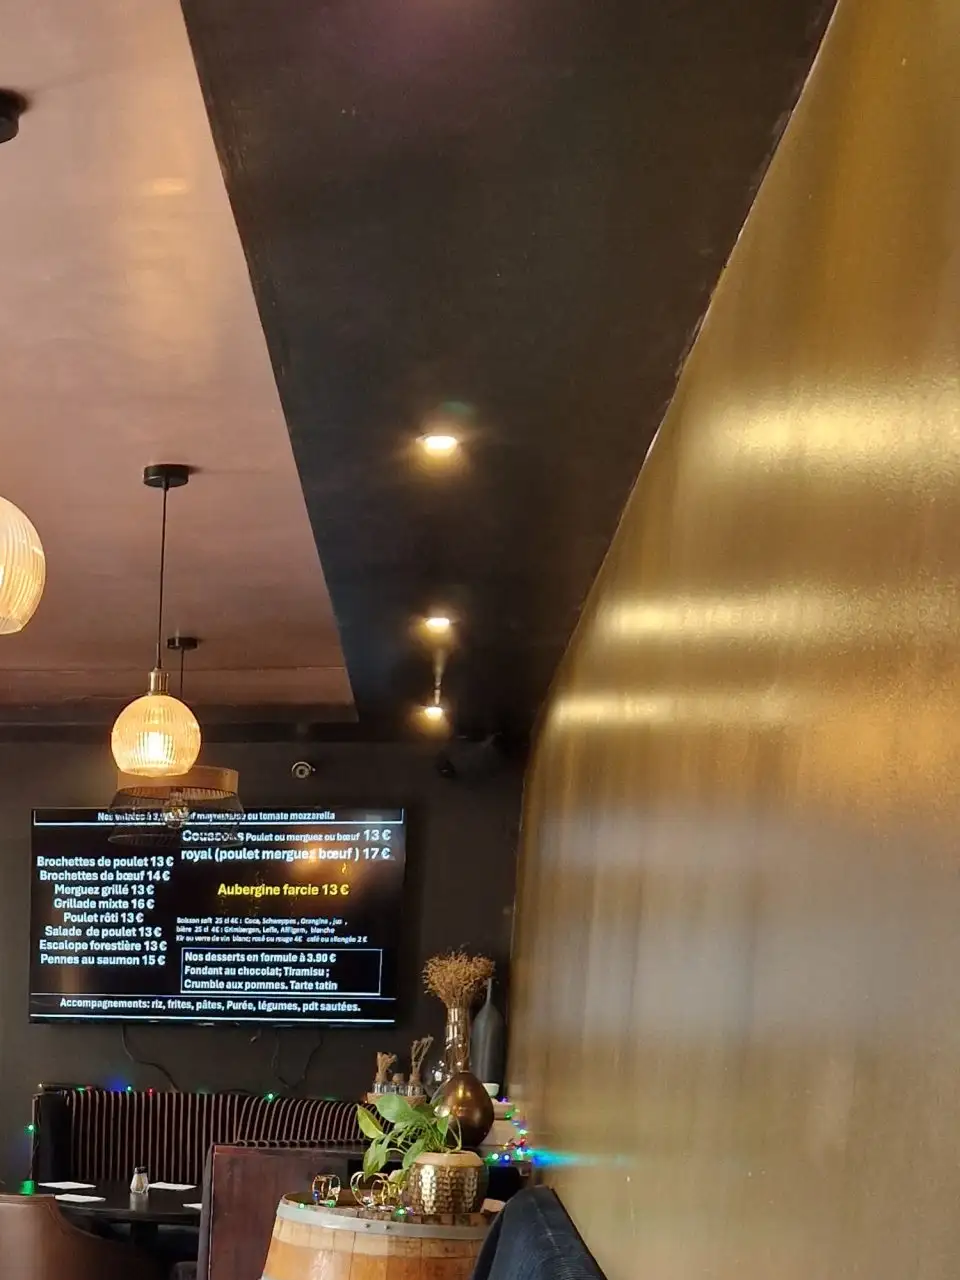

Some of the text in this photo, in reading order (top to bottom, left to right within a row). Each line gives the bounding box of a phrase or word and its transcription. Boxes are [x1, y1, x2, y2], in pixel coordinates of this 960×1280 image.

[259, 812, 288, 820] tomate
[290, 812, 335, 820] mozzarella
[246, 833, 273, 841] Poulet
[287, 834, 323, 842] merguez
[364, 830, 379, 841] 13
[382, 830, 391, 841] €
[181, 848, 212, 862] royal
[215, 848, 260, 862] (poulet
[262, 850, 317, 862] merguez
[363, 848, 379, 859] 17
[381, 848, 390, 859] €
[37, 856, 95, 866] Brochettes
[97, 856, 111, 867] de
[113, 856, 148, 868] poulet
[151, 856, 164, 867] 13
[40, 870, 98, 880] Brochettes
[100, 870, 114, 880] de
[116, 870, 145, 881] bœuf
[147, 871, 160, 881] 14
[55, 884, 100, 896] Merguez
[102, 884, 129, 896] grillé
[131, 884, 144, 895] 13
[218, 884, 349, 897] Aubergine farcie 13 €
[54, 898, 96, 908] Grillade
[99, 898, 129, 909] mixte
[131, 899, 145, 909] 16
[64, 912, 98, 922] Poulet
[100, 912, 118, 923] rôti
[121, 913, 134, 923] 13
[45, 926, 82, 936] Salade
[86, 926, 99, 936] de
[102, 927, 136, 938] poulet
[139, 927, 152, 937] 13
[40, 940, 88, 952] Escalope
[90, 940, 141, 951] forestière
[144, 941, 157, 951] 13
[41, 954, 79, 964] Pennes
[81, 956, 94, 964] au
[97, 957, 139, 965] saumon
[142, 955, 155, 965] 15
[185, 952, 336, 962] Nos desserts en formule à 3.90 €
[185, 966, 223, 975] Fondant
[238, 966, 282, 977] chocolat;
[283, 967, 324, 976] Tiramisu
[184, 979, 337, 991] Crumble aux pommes. Tarte tatin
[60, 998, 360, 1012] Accompagnements: riz, frites, pâtes, Purée, légumes, pdt sautées.
